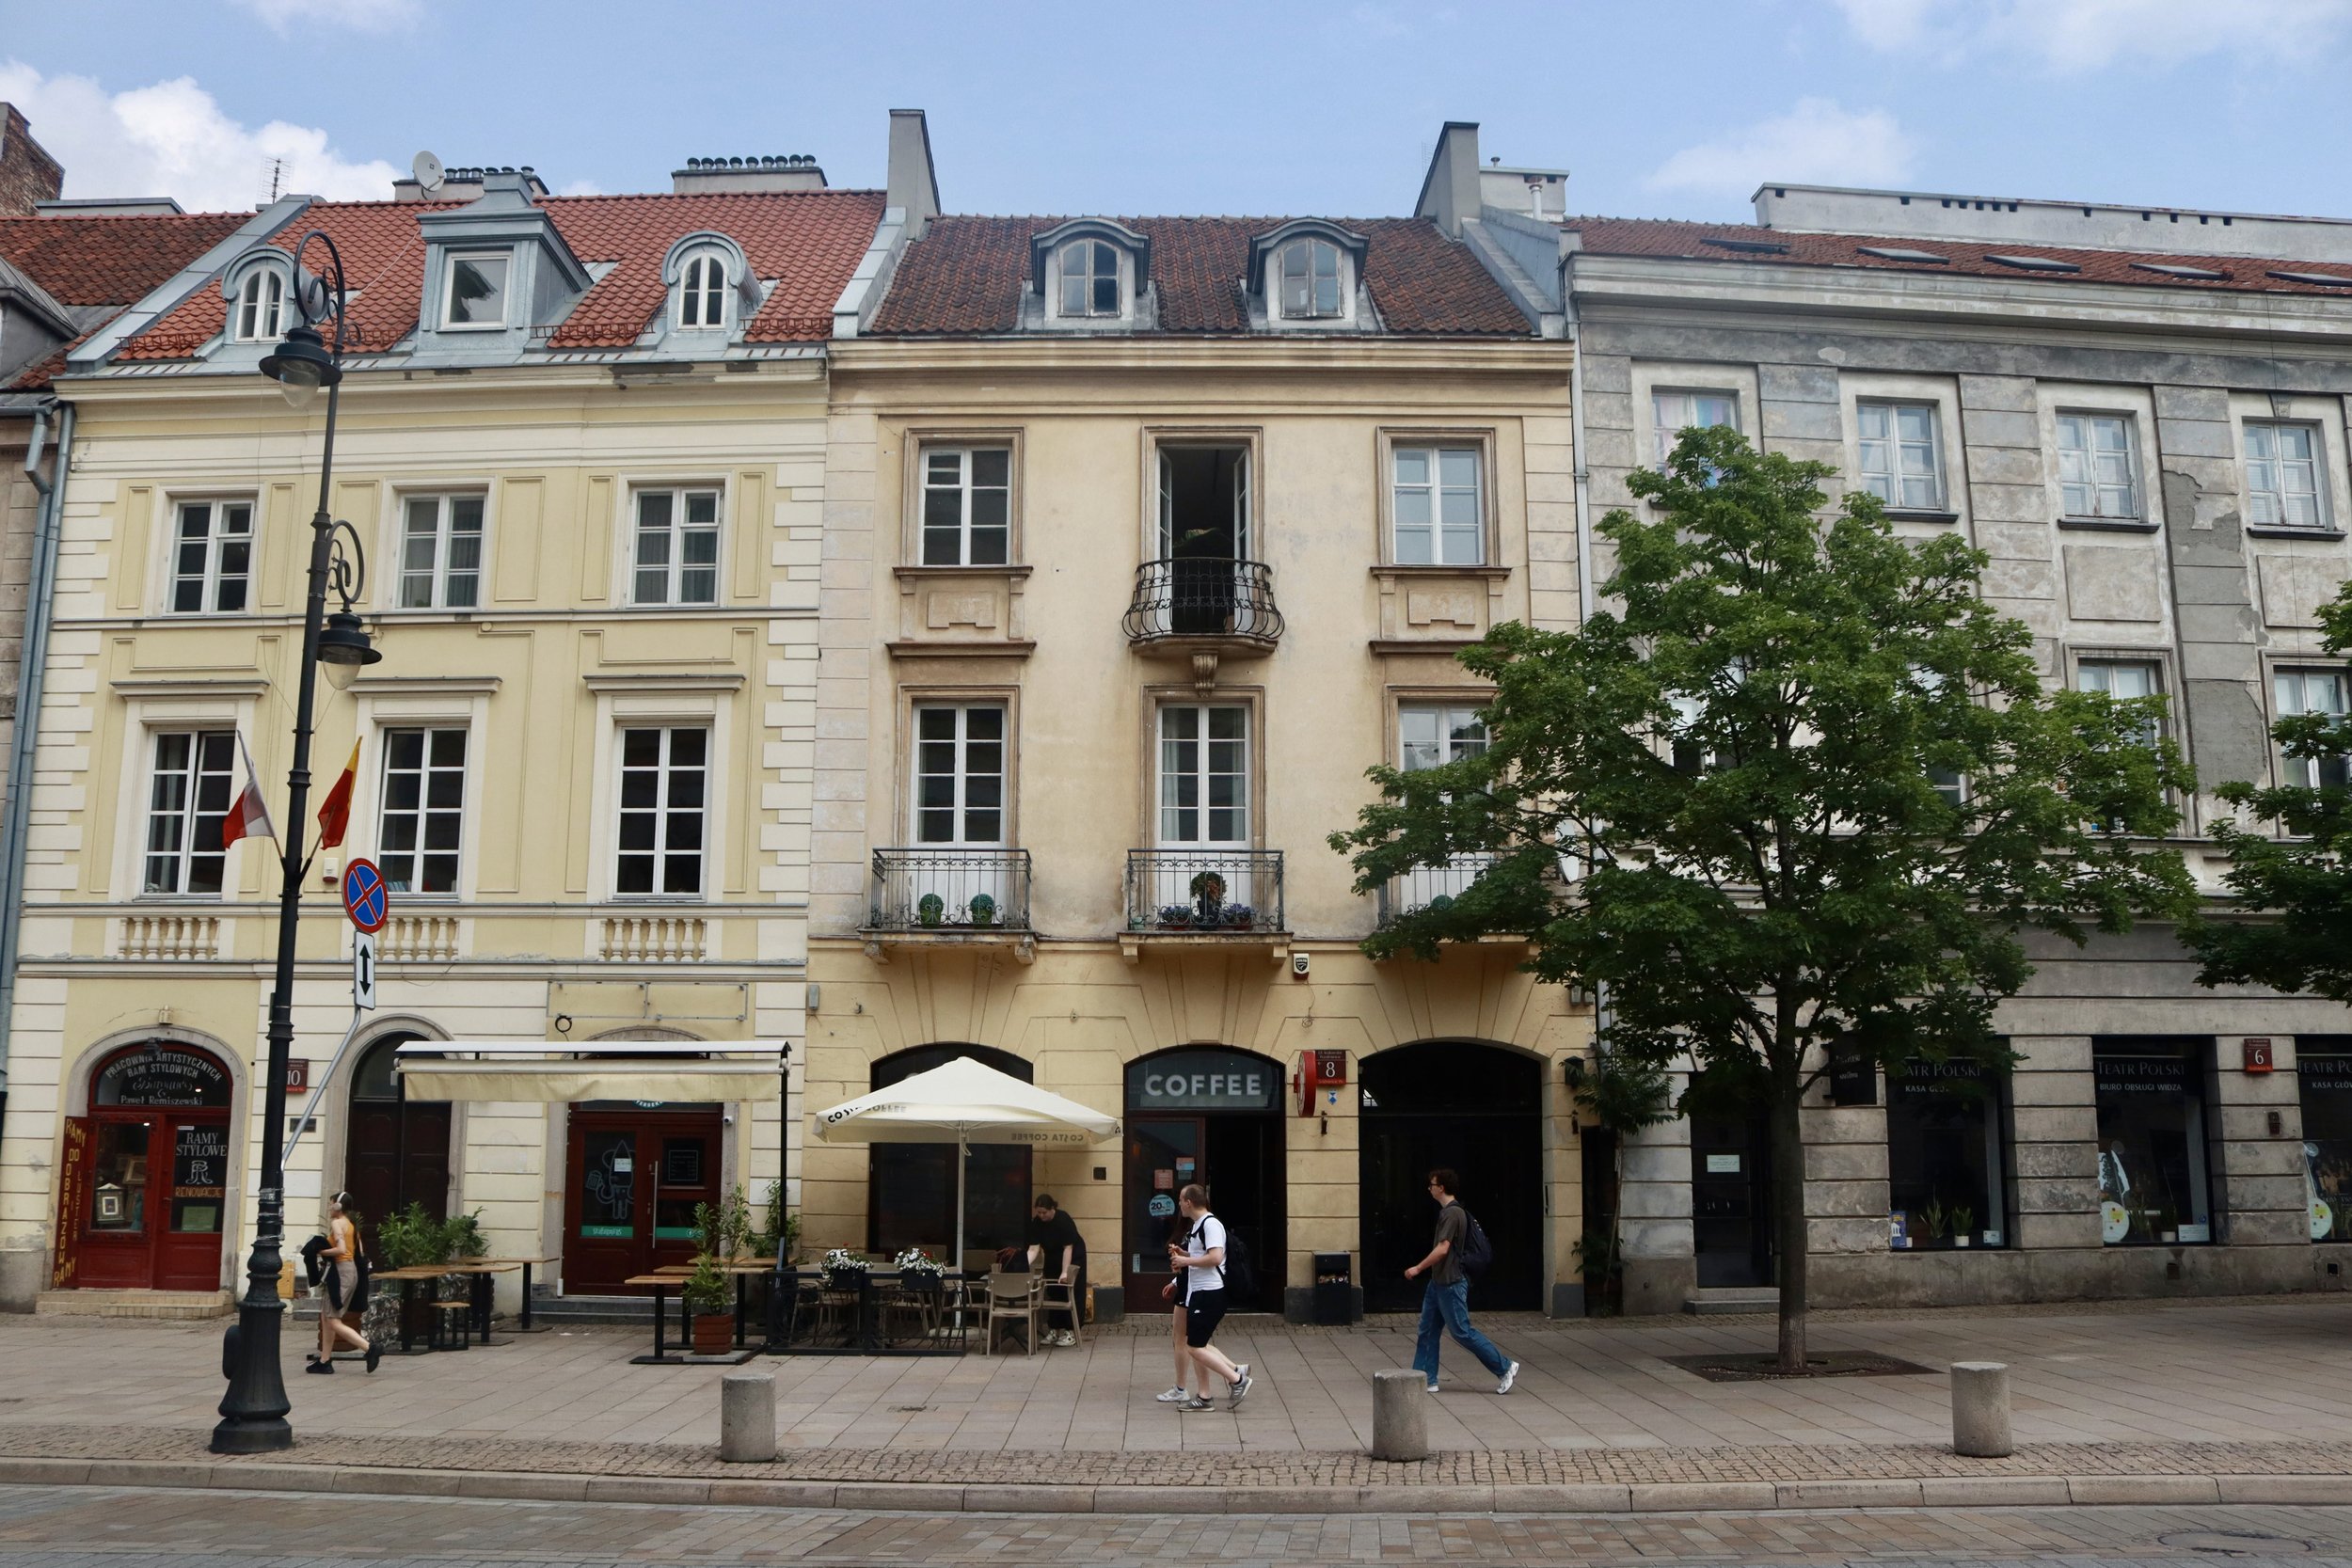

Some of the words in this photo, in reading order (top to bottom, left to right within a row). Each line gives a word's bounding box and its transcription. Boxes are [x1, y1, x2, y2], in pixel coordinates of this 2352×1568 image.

[2254, 1049, 2265, 1065] 6
[105, 1054, 153, 1078] PRACOWNIA
[156, 1053, 222, 1082] ARTYSTYCZNYCH
[126, 1065, 147, 1078] RAM
[151, 1063, 199, 1079] STYLOWYCH
[1326, 1061, 1336, 1078] 8
[1933, 1063, 1980, 1077] POLSKI
[2097, 1060, 2136, 1075] TEATR
[2139, 1061, 2185, 1076] POLSKI
[2297, 1060, 2333, 1073] TEATR
[287, 1069, 301, 1085] 10
[1144, 1074, 1263, 1097] COFFEE
[149, 1095, 203, 1106] Remiszewski
[66, 1118, 87, 1148] RAMY
[186, 1132, 218, 1145] RAMY
[69, 1148, 80, 1162] DO
[176, 1145, 228, 1157] STYLOWE
[175, 1187, 223, 1197] RENOWACJE
[53, 1256, 77, 1288] RAMY
